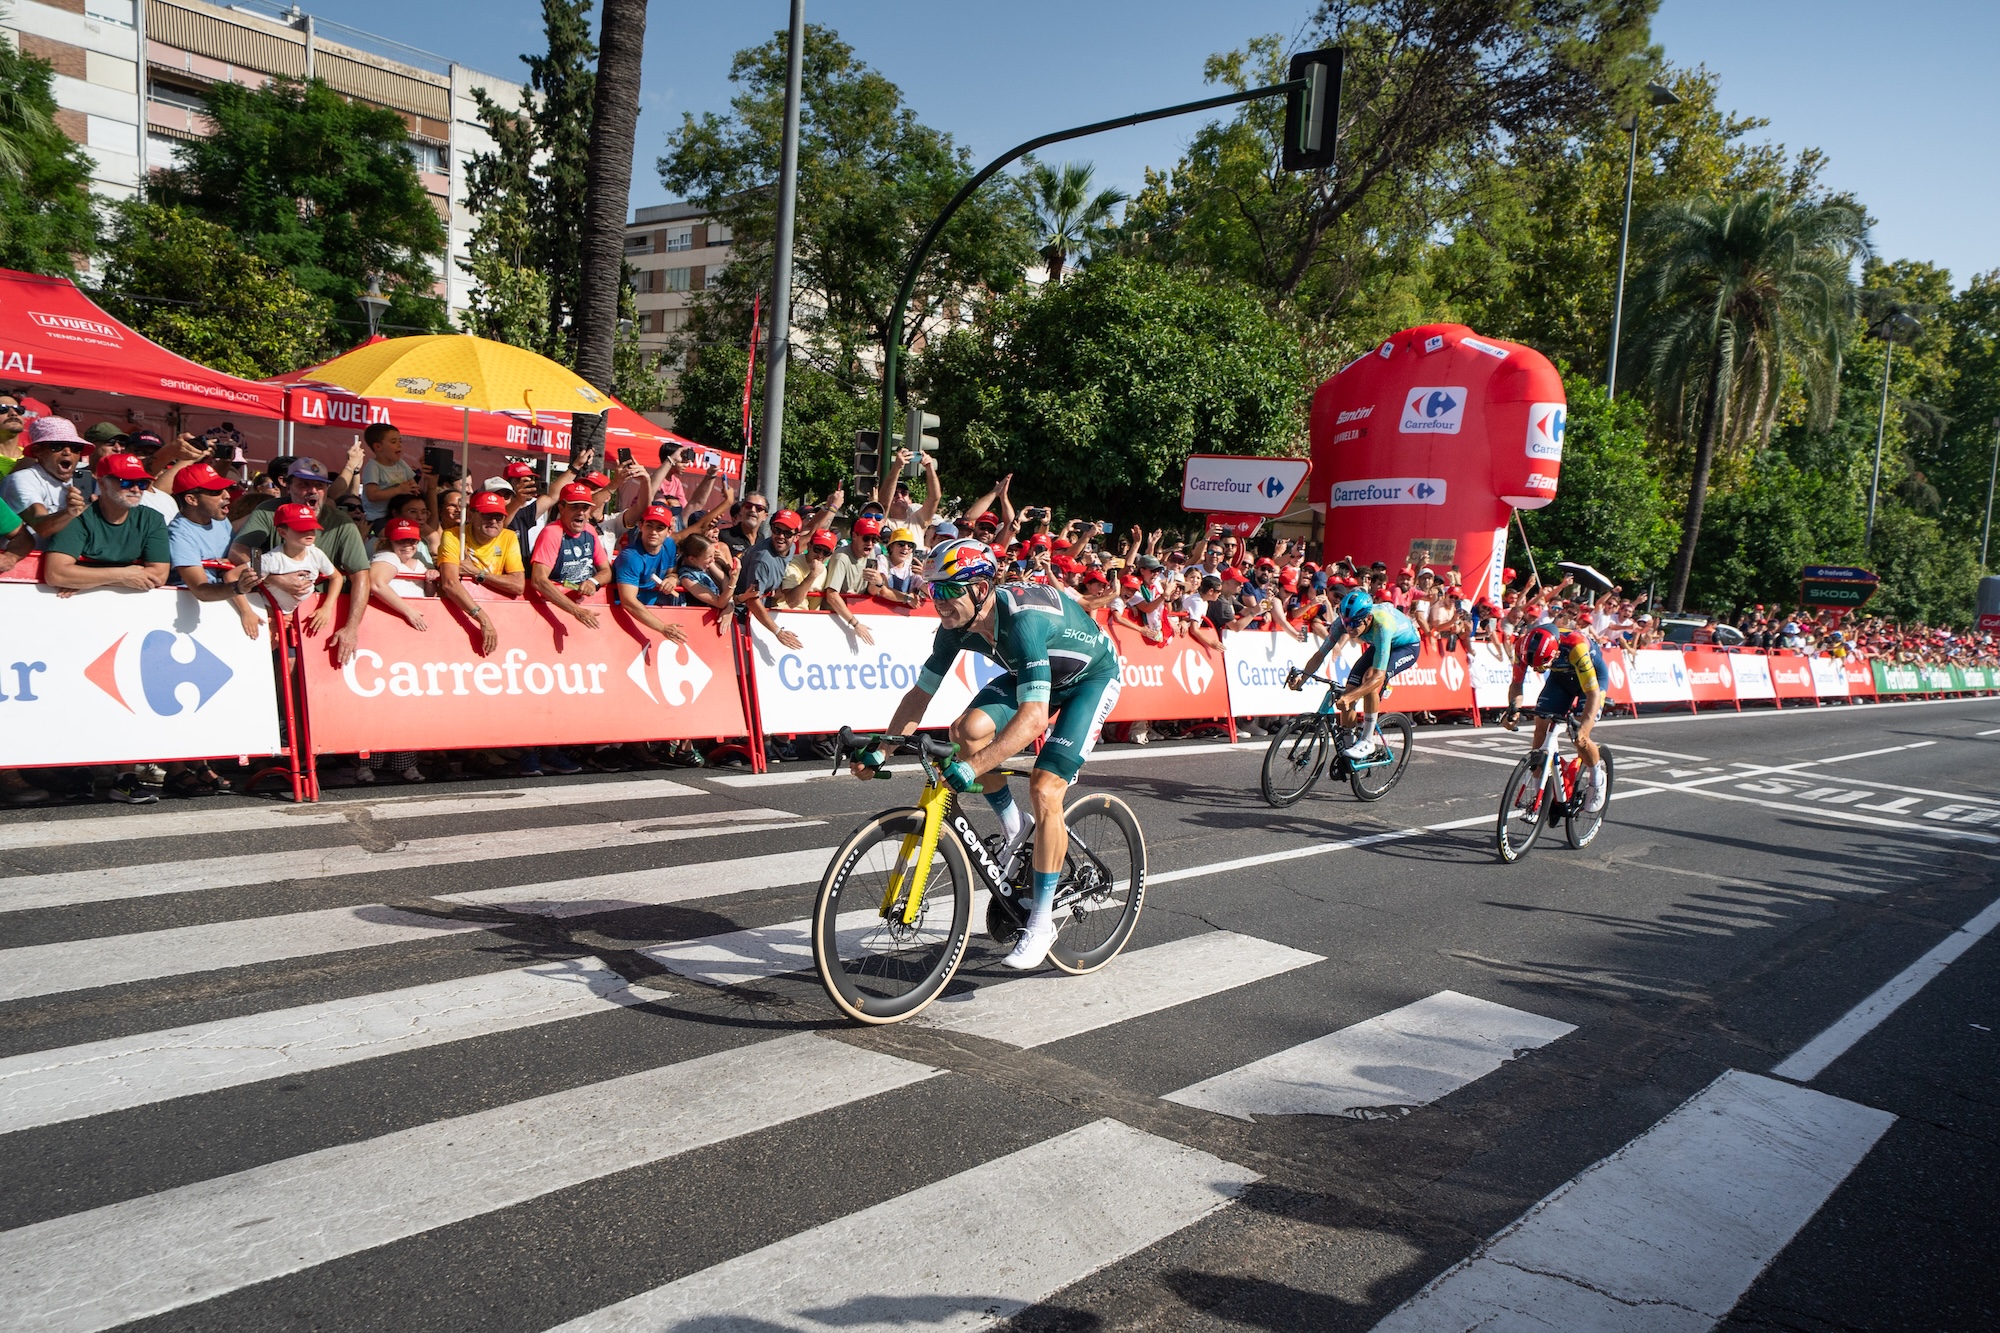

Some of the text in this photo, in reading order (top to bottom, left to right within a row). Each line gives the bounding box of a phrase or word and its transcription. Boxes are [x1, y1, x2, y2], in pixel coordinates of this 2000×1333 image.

[39, 315, 114, 336] LA VUELTA
[45, 331, 122, 349] TIENDA OFICIAL
[160, 378, 259, 402] santinicycling.com
[302, 396, 391, 425] LA VUELTA
[1336, 404, 1375, 425] Santini
[1405, 419, 1455, 430] Carrefour
[506, 424, 554, 448] OFFICIAL
[1190, 477, 1252, 493] Carrefour
[1335, 484, 1402, 502] Carrefour
[1824, 569, 1853, 577] helvetia
[1394, 654, 1415, 669] ASTANA
[342, 648, 608, 697] Carrefour
[1629, 666, 1668, 684] Carrefour
[1687, 667, 1719, 684] Carrefour
[831, 848, 860, 898] RESERVE
[1056, 893, 1082, 908] SRAM
[940, 933, 965, 979] RESERVE
